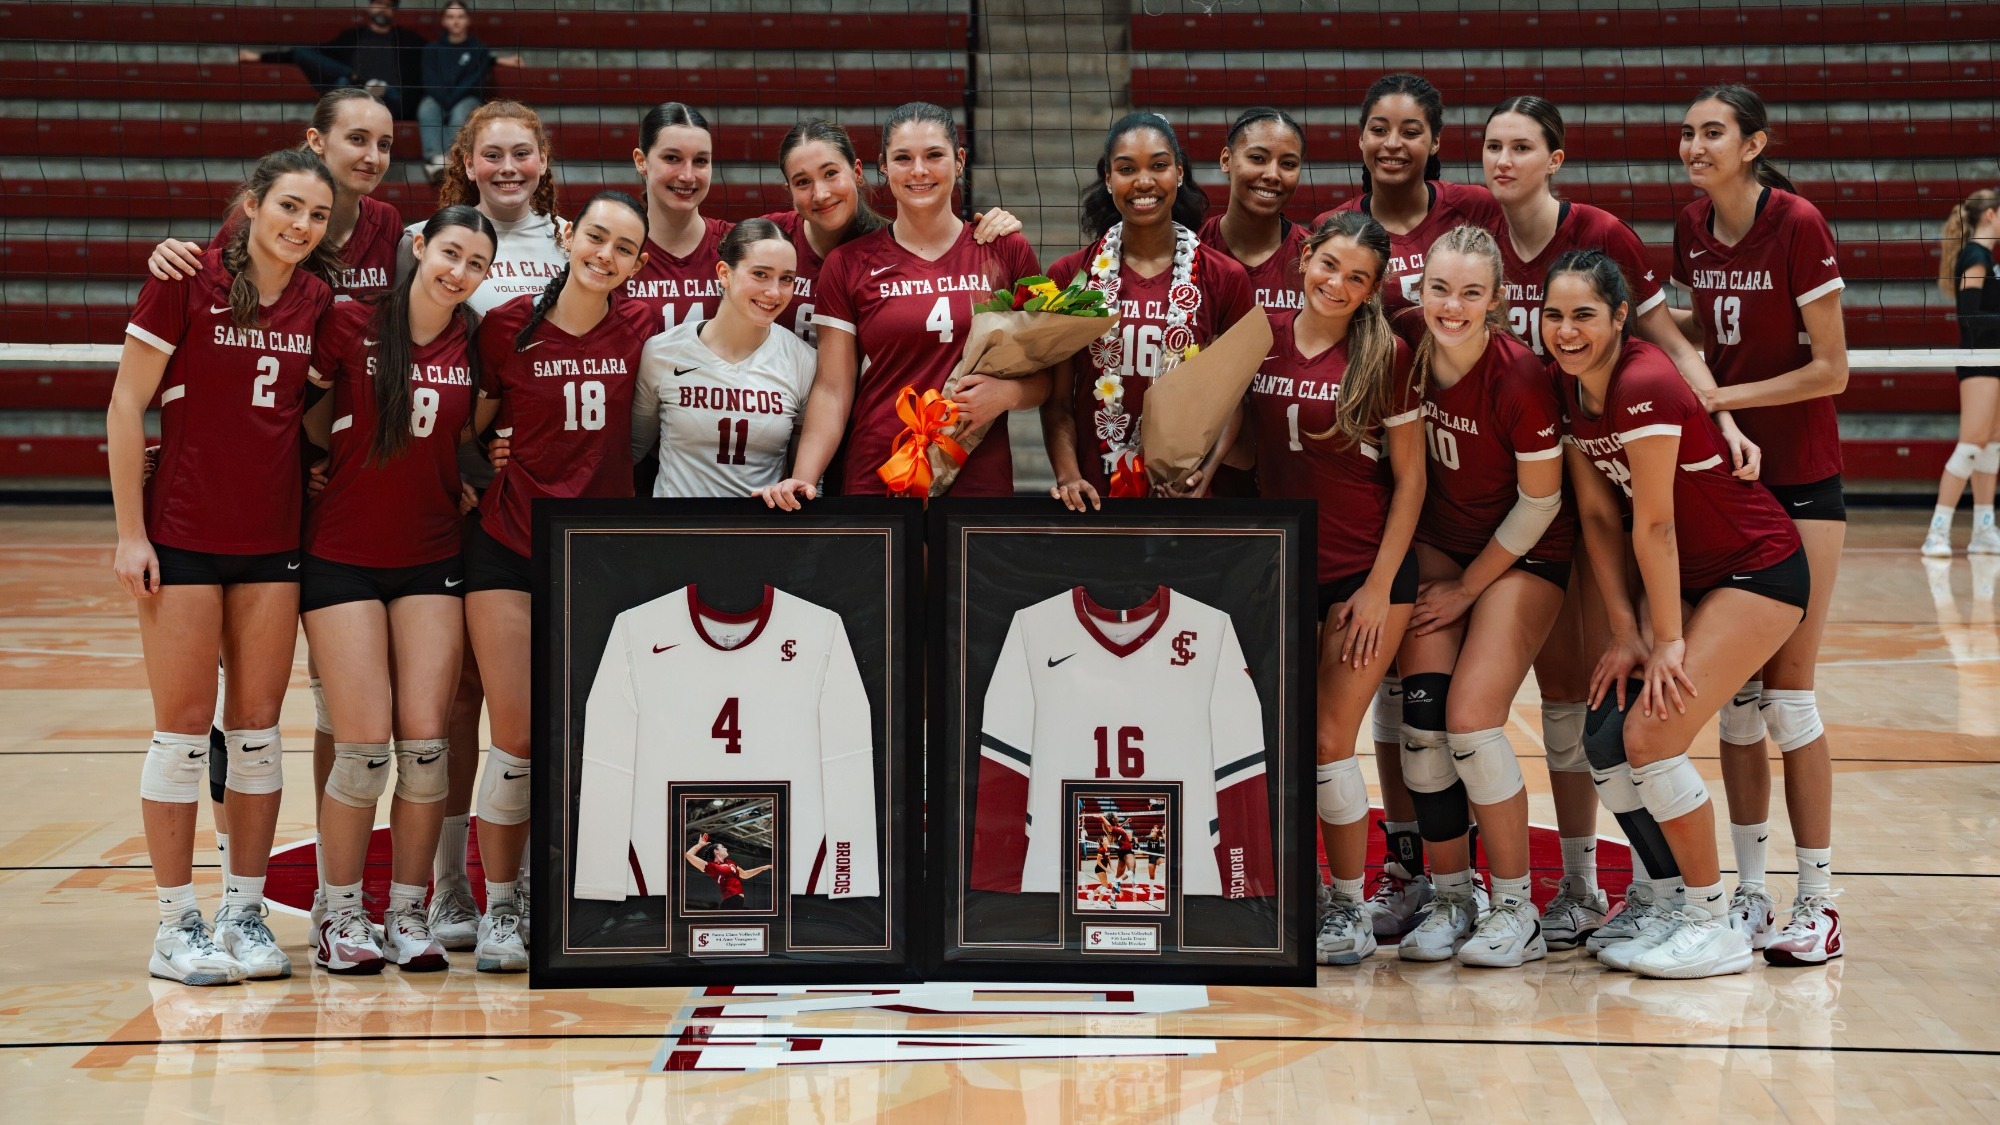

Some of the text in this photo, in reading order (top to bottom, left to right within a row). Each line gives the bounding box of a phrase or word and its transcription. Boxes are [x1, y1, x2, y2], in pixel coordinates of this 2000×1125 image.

[494, 285, 546, 293] VOLLEYBA
[626, 279, 724, 298] SANTA CLAR
[880, 274, 992, 299] SANTA CLARA
[1693, 269, 1774, 291] SANTA CLARA
[213, 325, 312, 355] SANTA CLARA
[926, 296, 954, 343] 4
[1713, 295, 1742, 346] 13
[426, 365, 473, 386] CLARA
[534, 358, 628, 377] SANTA CLARA
[1120, 324, 1163, 378] 16
[251, 355, 280, 409] 2
[563, 380, 606, 431] 18
[678, 386, 783, 415] BRONCOS
[1252, 372, 1341, 402] SANTA CLAR
[409, 387, 440, 438] 8
[1286, 403, 1304, 452] 1
[1440, 410, 1479, 436] CLARA
[716, 417, 749, 466] 11
[1425, 420, 1461, 472] 10
[711, 697, 742, 754] 4
[1093, 725, 1146, 779] 16
[833, 841, 851, 895] BRONCOS
[1229, 847, 1245, 899] BRONCOS
